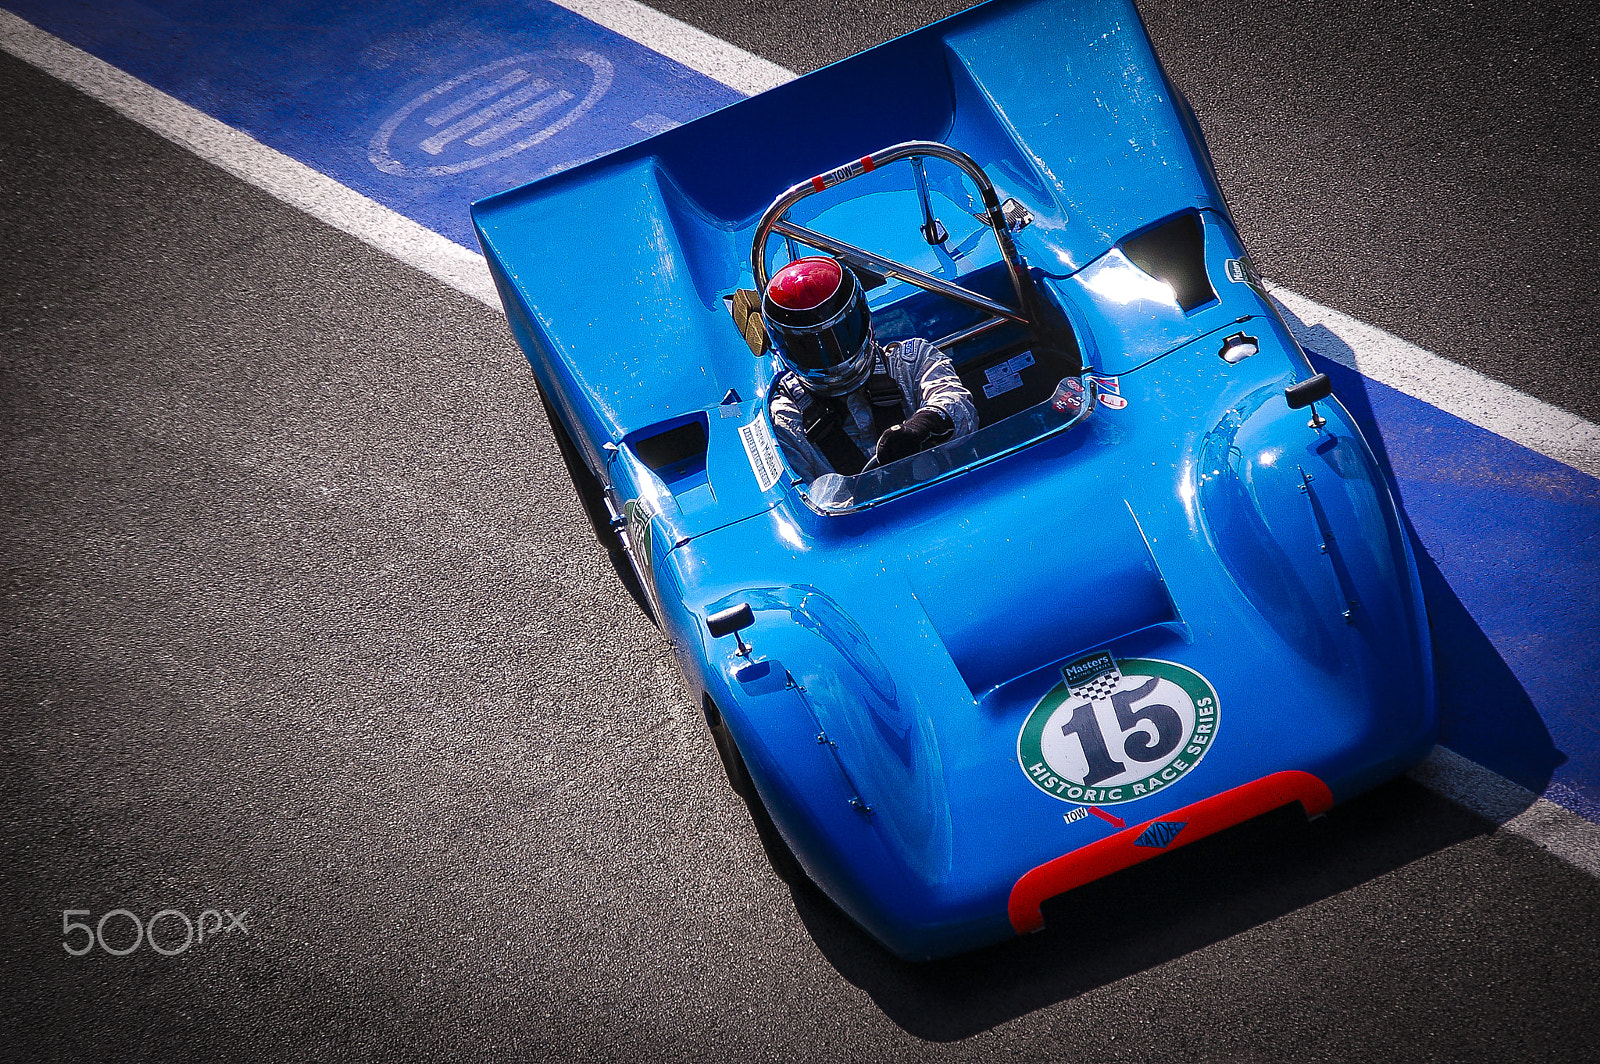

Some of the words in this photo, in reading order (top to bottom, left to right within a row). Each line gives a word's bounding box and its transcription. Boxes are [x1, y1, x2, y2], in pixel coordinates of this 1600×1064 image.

[831, 165, 853, 182] TOW
[1065, 656, 1109, 677] Masters
[1061, 675, 1183, 786] 15
[1029, 762, 1122, 801] HISTORIC
[1133, 758, 1189, 796] RACE
[1187, 697, 1214, 756] SERIES
[1064, 807, 1088, 823] TOW
